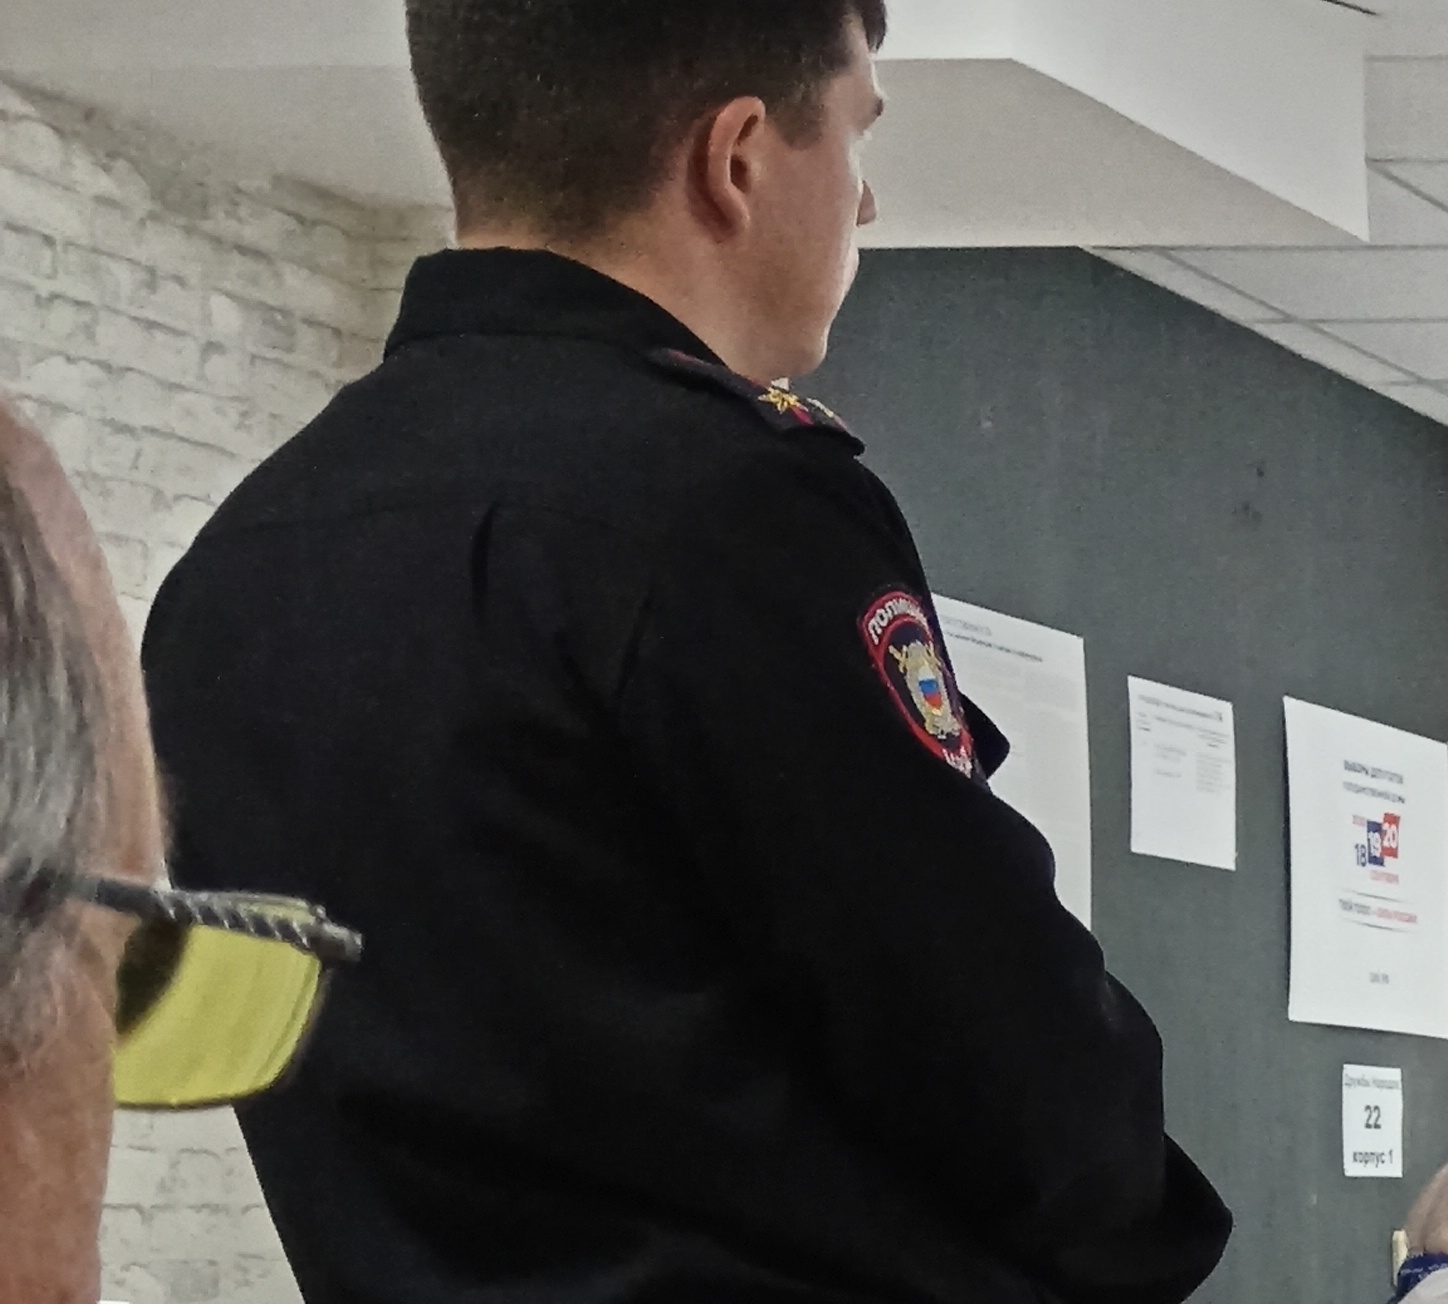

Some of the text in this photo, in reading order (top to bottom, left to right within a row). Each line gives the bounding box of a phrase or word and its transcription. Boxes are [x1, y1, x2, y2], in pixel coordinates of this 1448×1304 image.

[1354, 843, 1367, 867] 18
[1383, 823, 1397, 849] 20
[1364, 1104, 1382, 1130] 22
